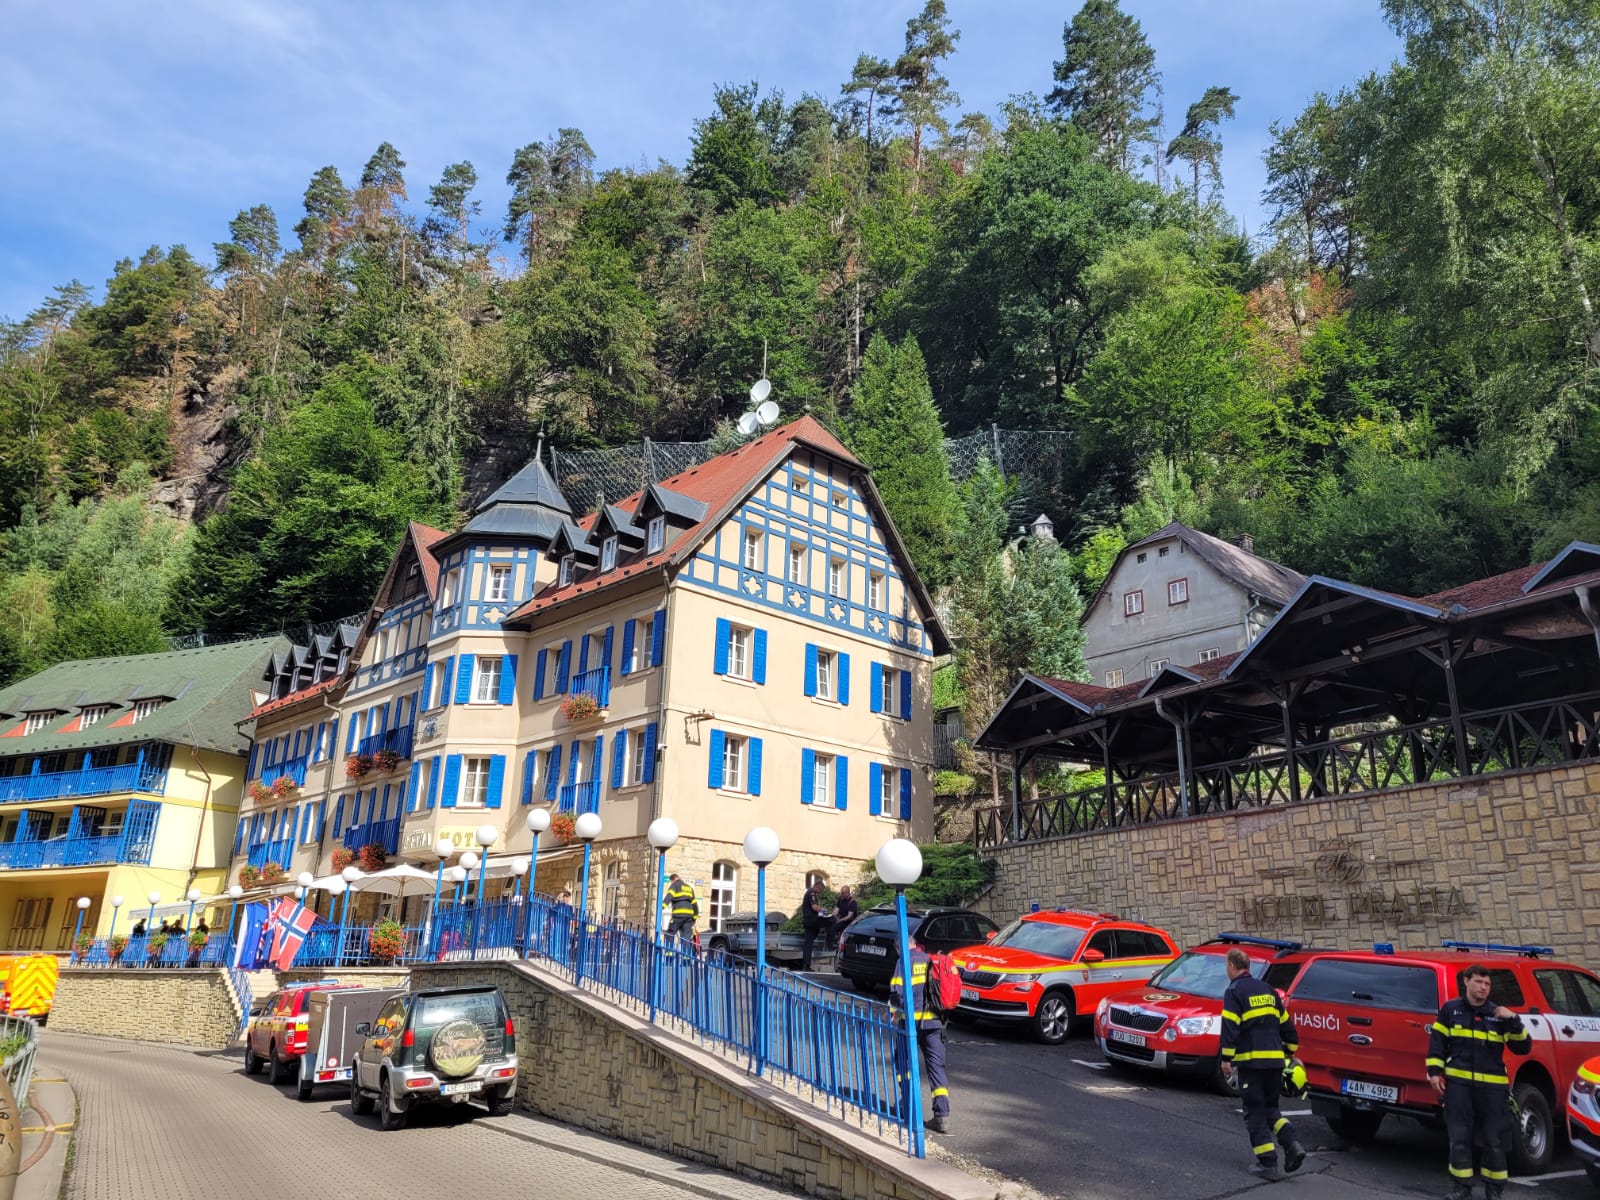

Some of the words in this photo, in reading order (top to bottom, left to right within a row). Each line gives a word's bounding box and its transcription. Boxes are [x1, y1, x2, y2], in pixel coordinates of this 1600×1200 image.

[1242, 894, 1338, 926] HOTEL
[1350, 885, 1472, 922] PRAHA
[1294, 1013, 1340, 1031] HASIČI
[1348, 1081, 1366, 1093] 4AN
[1371, 1086, 1394, 1099] 4982
